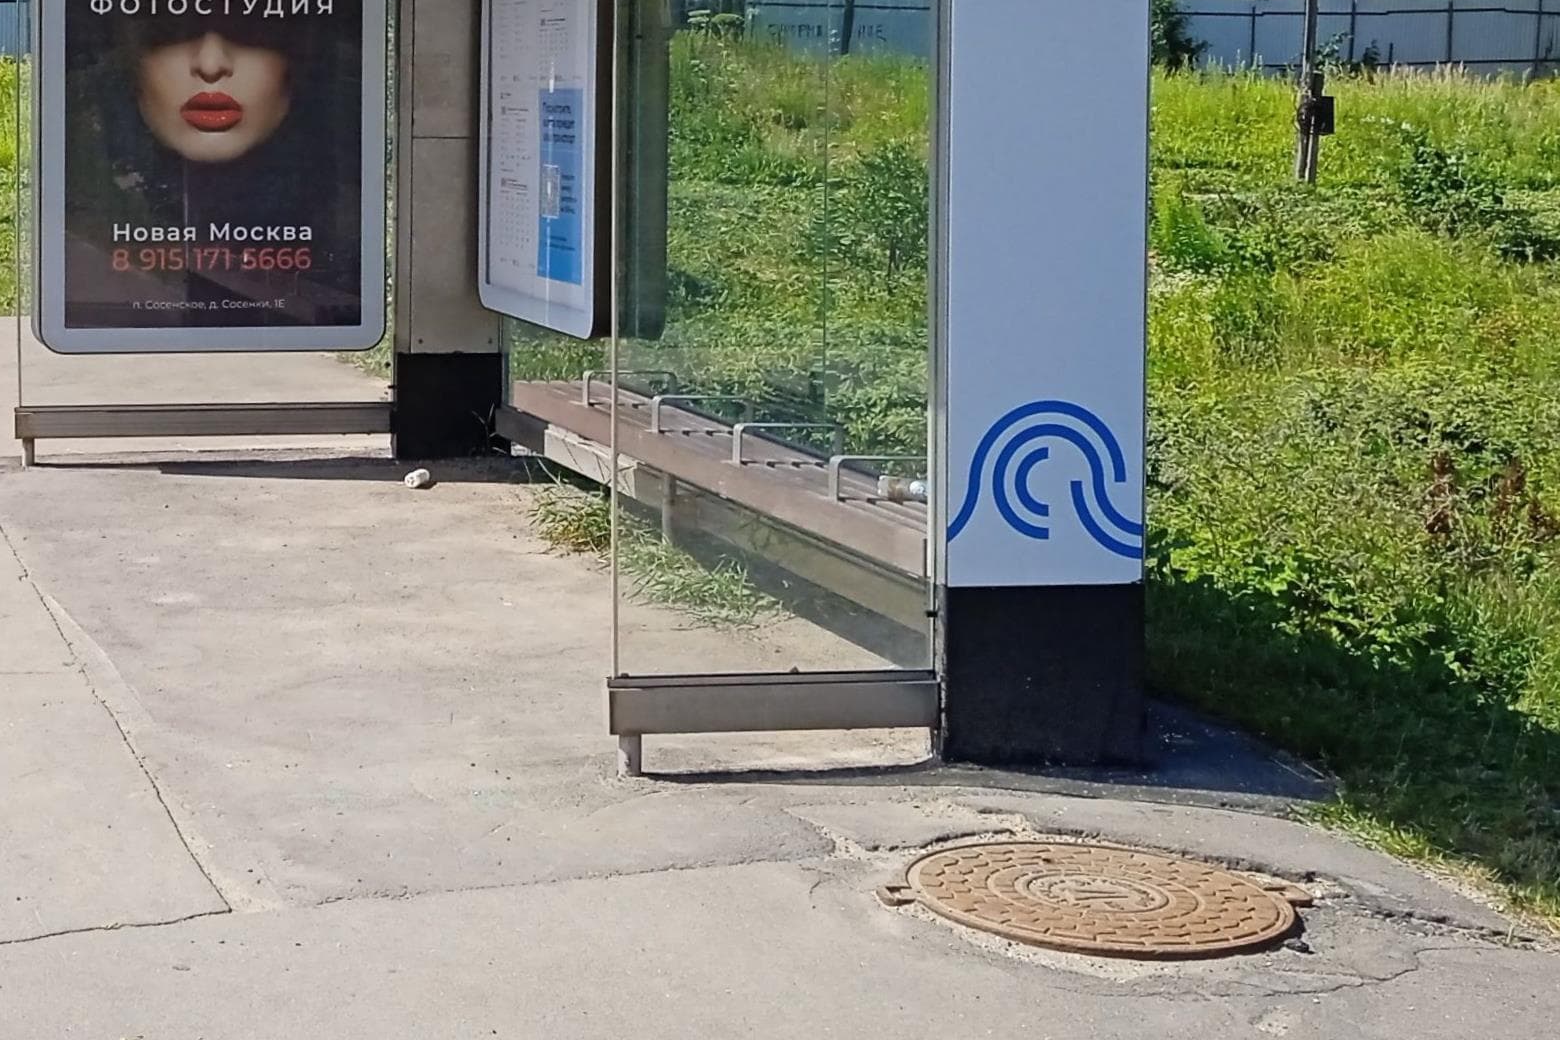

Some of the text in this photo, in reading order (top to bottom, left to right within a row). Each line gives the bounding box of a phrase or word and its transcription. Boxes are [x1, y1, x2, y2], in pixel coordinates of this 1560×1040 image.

[113, 222, 313, 241] Новая Москва
[112, 247, 312, 271] 8 915 171 5666
